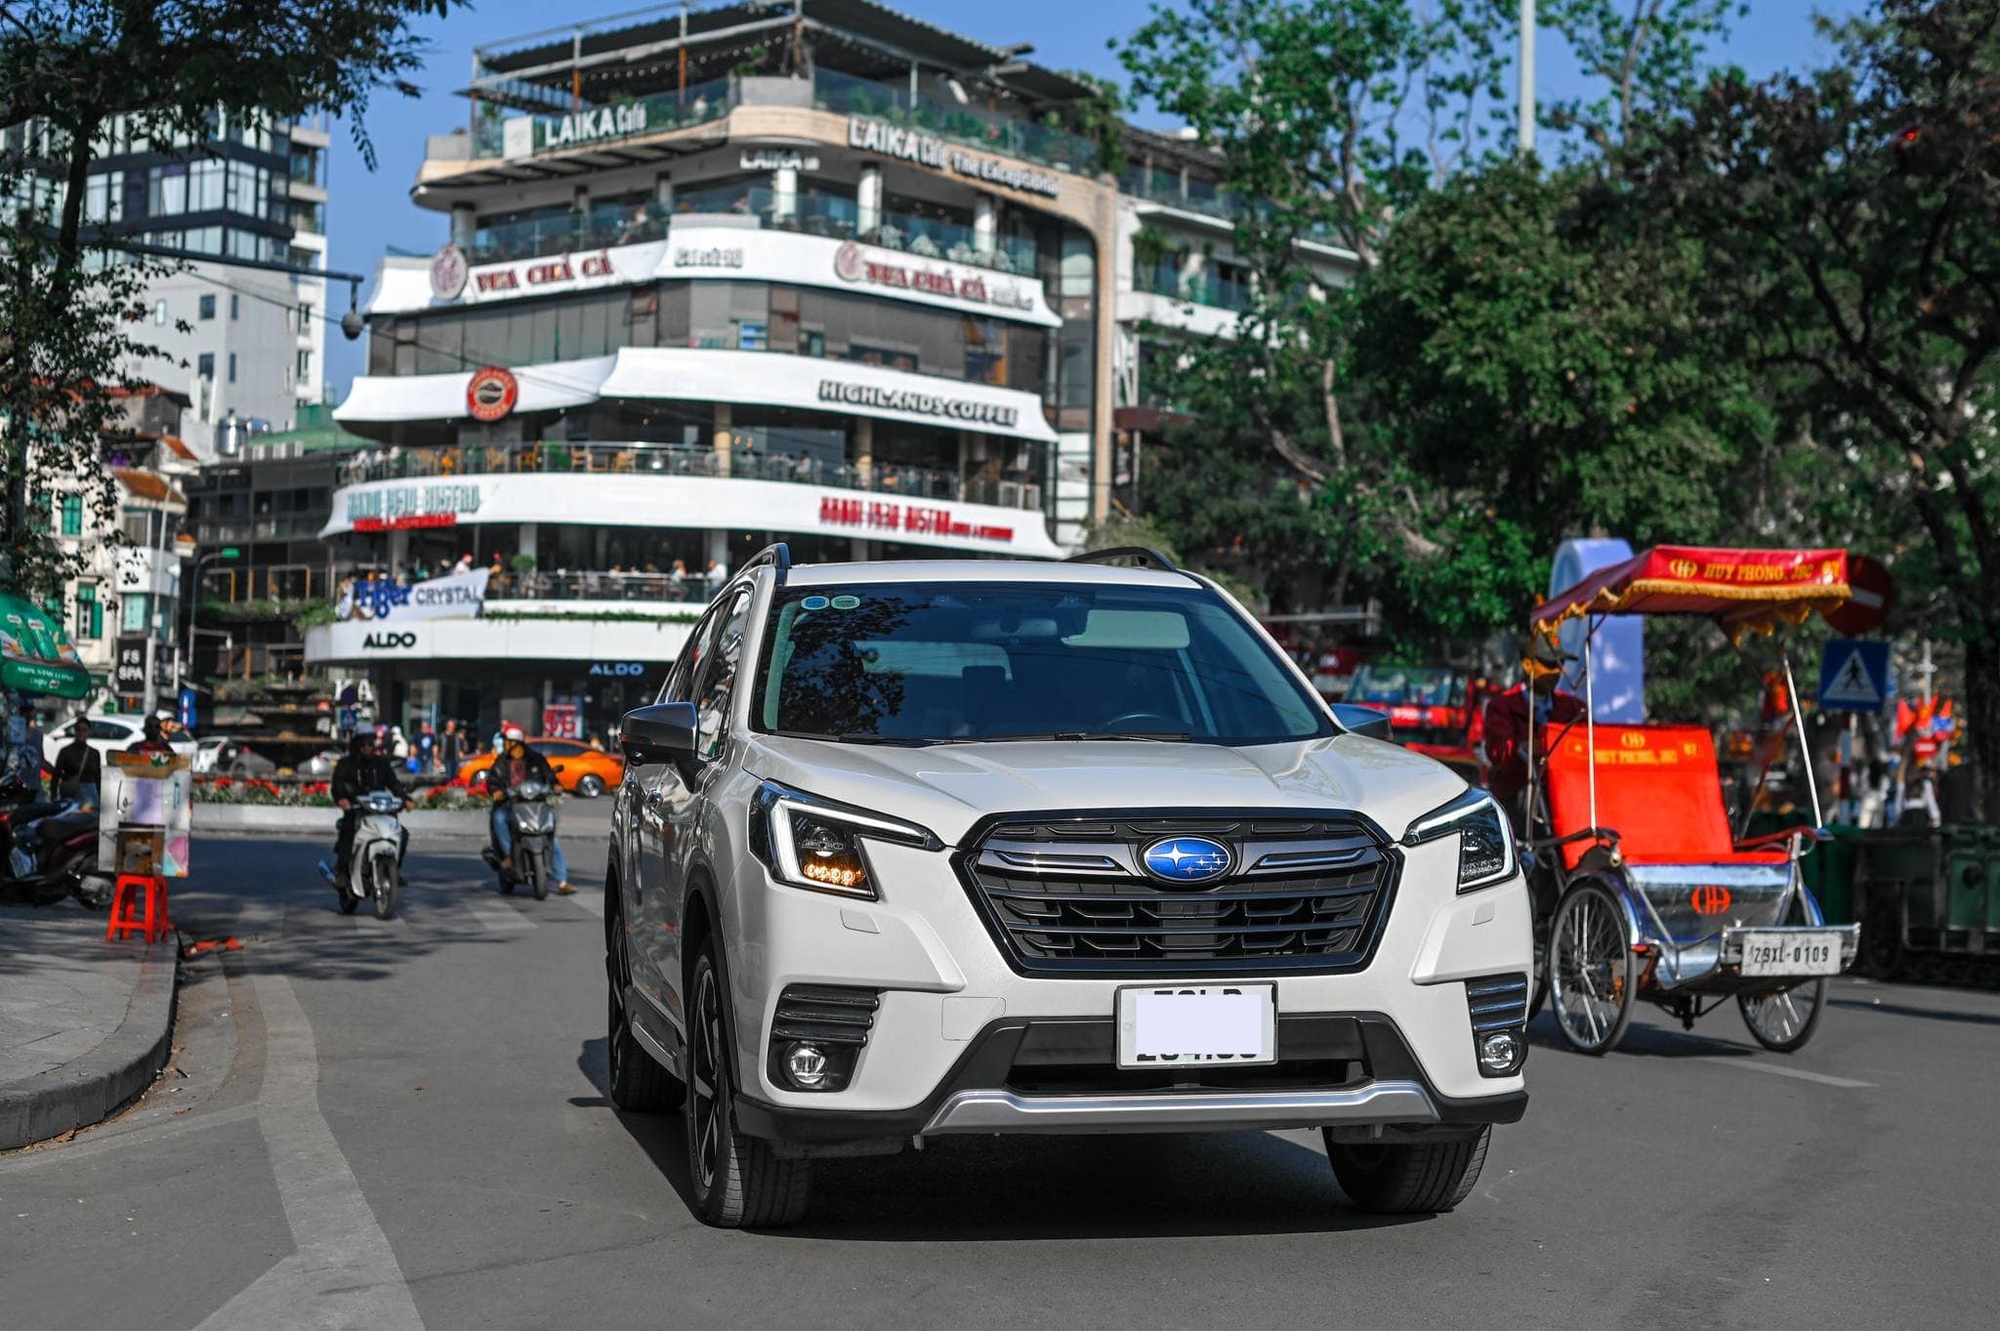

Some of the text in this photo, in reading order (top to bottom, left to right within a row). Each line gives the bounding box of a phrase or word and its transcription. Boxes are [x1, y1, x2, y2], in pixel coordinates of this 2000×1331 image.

[545, 107, 615, 146] LAIKA
[850, 116, 919, 162] LAIKA
[818, 379, 1019, 426] HIGHLANDS COFFEE
[1704, 563, 1735, 579] HUY
[415, 585, 482, 605] CRYSTAL
[363, 632, 416, 649] ALDO
[123, 649, 140, 664] FS
[119, 665, 143, 680] SPA
[589, 663, 644, 676] ALDO
